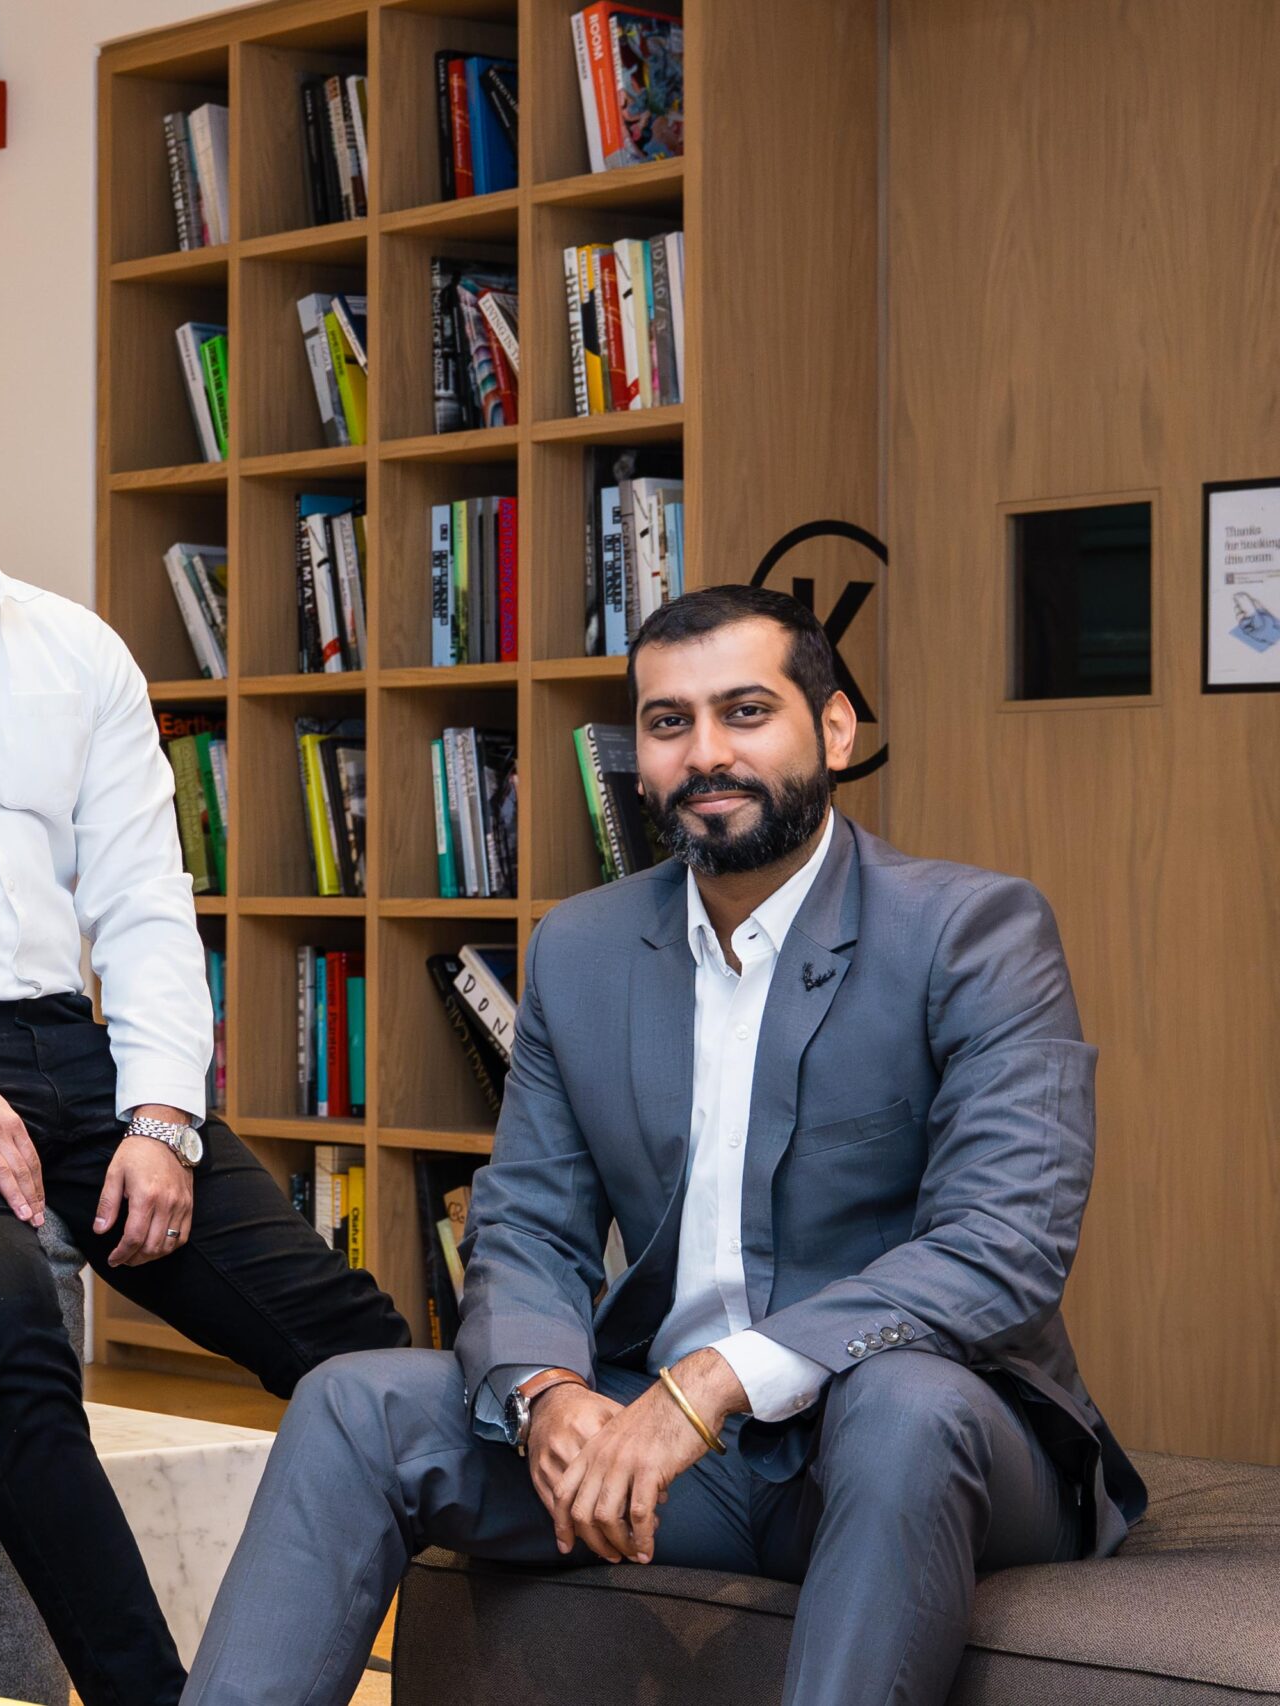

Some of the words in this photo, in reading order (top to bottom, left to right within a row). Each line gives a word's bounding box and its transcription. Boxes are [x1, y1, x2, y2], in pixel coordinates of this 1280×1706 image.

[589, 13, 604, 61] ROOM
[300, 519, 313, 615] ANIMAL
[501, 501, 513, 594] ANTHONY
[1225, 525, 1262, 537] Thanks
[502, 598, 515, 654] CARO
[793, 577, 877, 723] K
